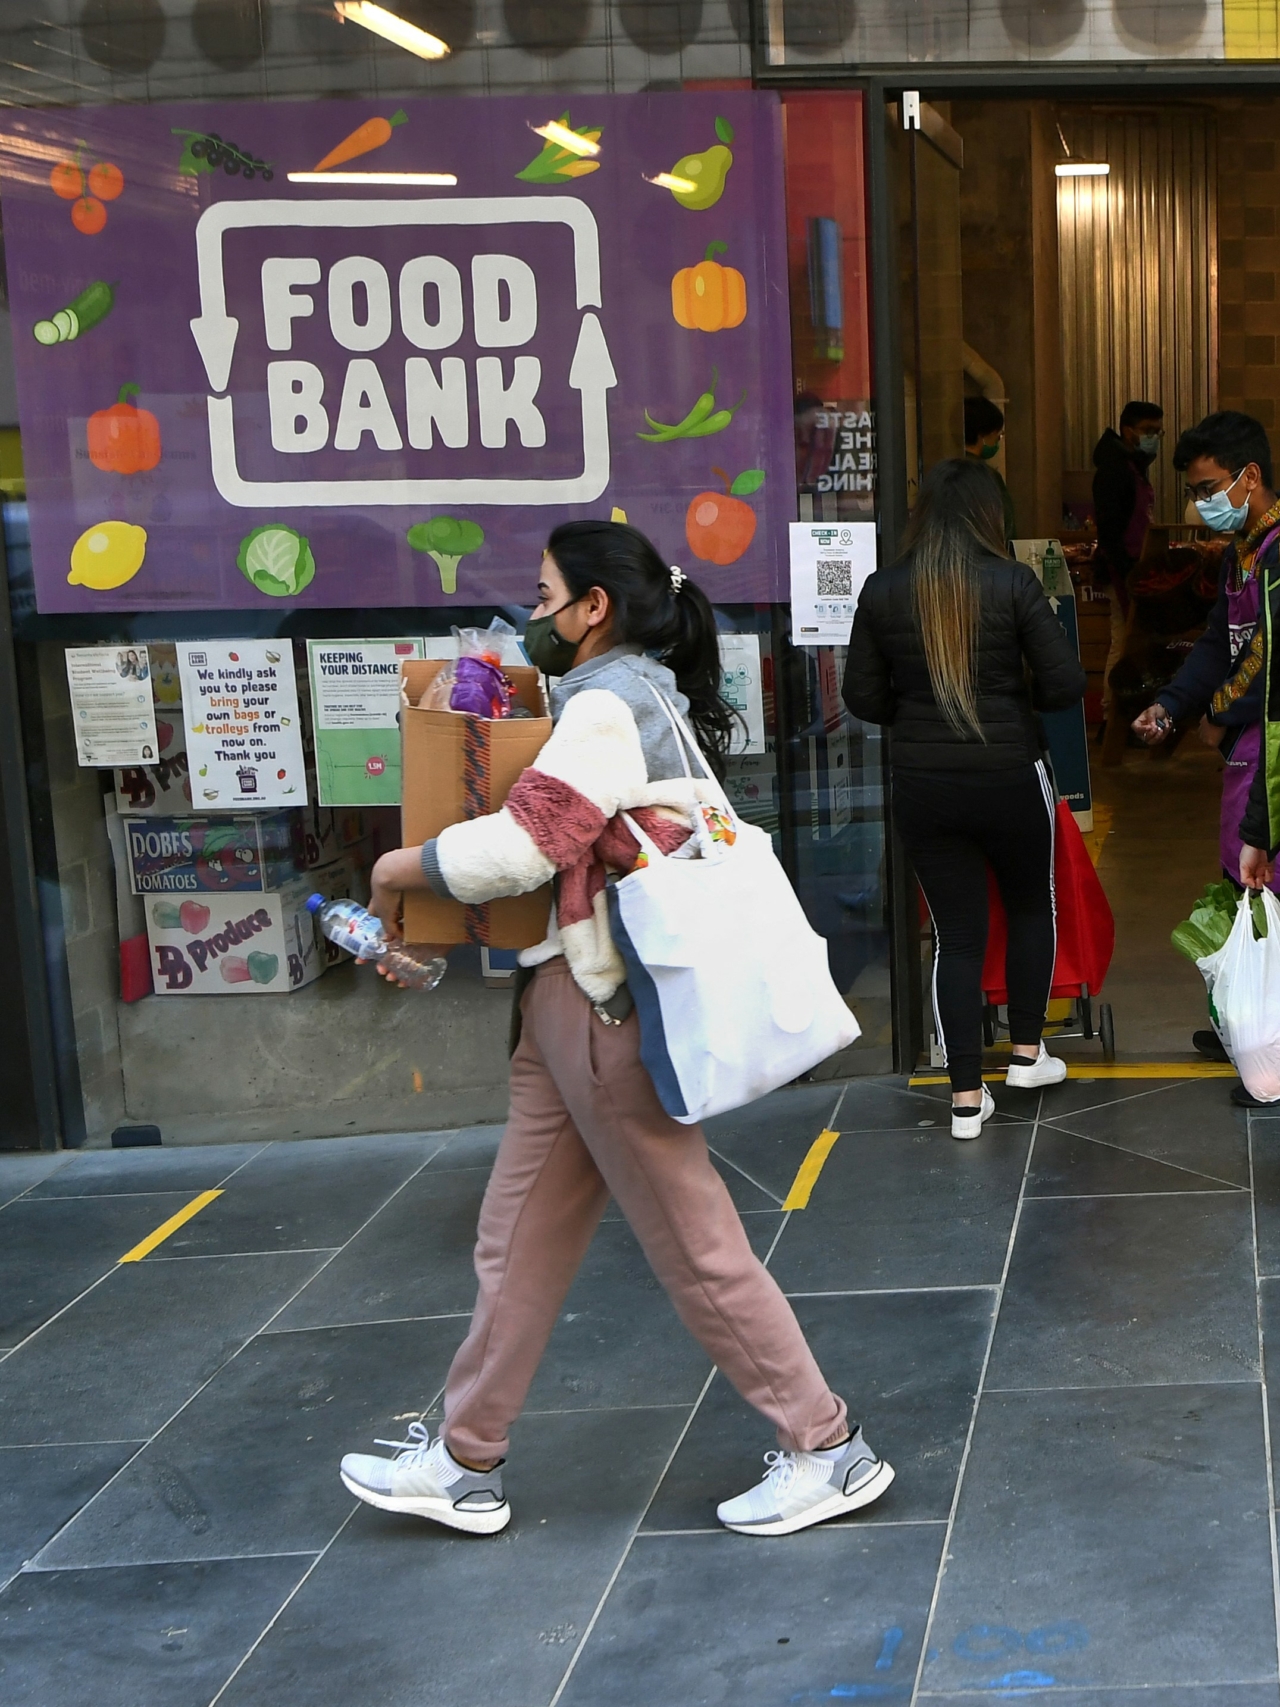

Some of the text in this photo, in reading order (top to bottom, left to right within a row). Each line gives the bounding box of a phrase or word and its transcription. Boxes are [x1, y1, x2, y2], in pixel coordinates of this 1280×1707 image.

[261, 254, 537, 351] FOOD
[267, 356, 546, 453] BANK
[320, 652, 363, 663] KEEPING
[197, 668, 276, 680] We kindly ask
[320, 664, 399, 676] YOUR DISTANCE
[200, 682, 277, 696] you to please
[210, 696, 270, 708] bring your
[206, 710, 276, 721] own bags or
[205, 723, 280, 735] trolleys from
[222, 738, 267, 747] now on.
[214, 750, 276, 762] Thank you
[136, 874, 198, 890] TOMATOES
[186, 908, 272, 973] Produce
